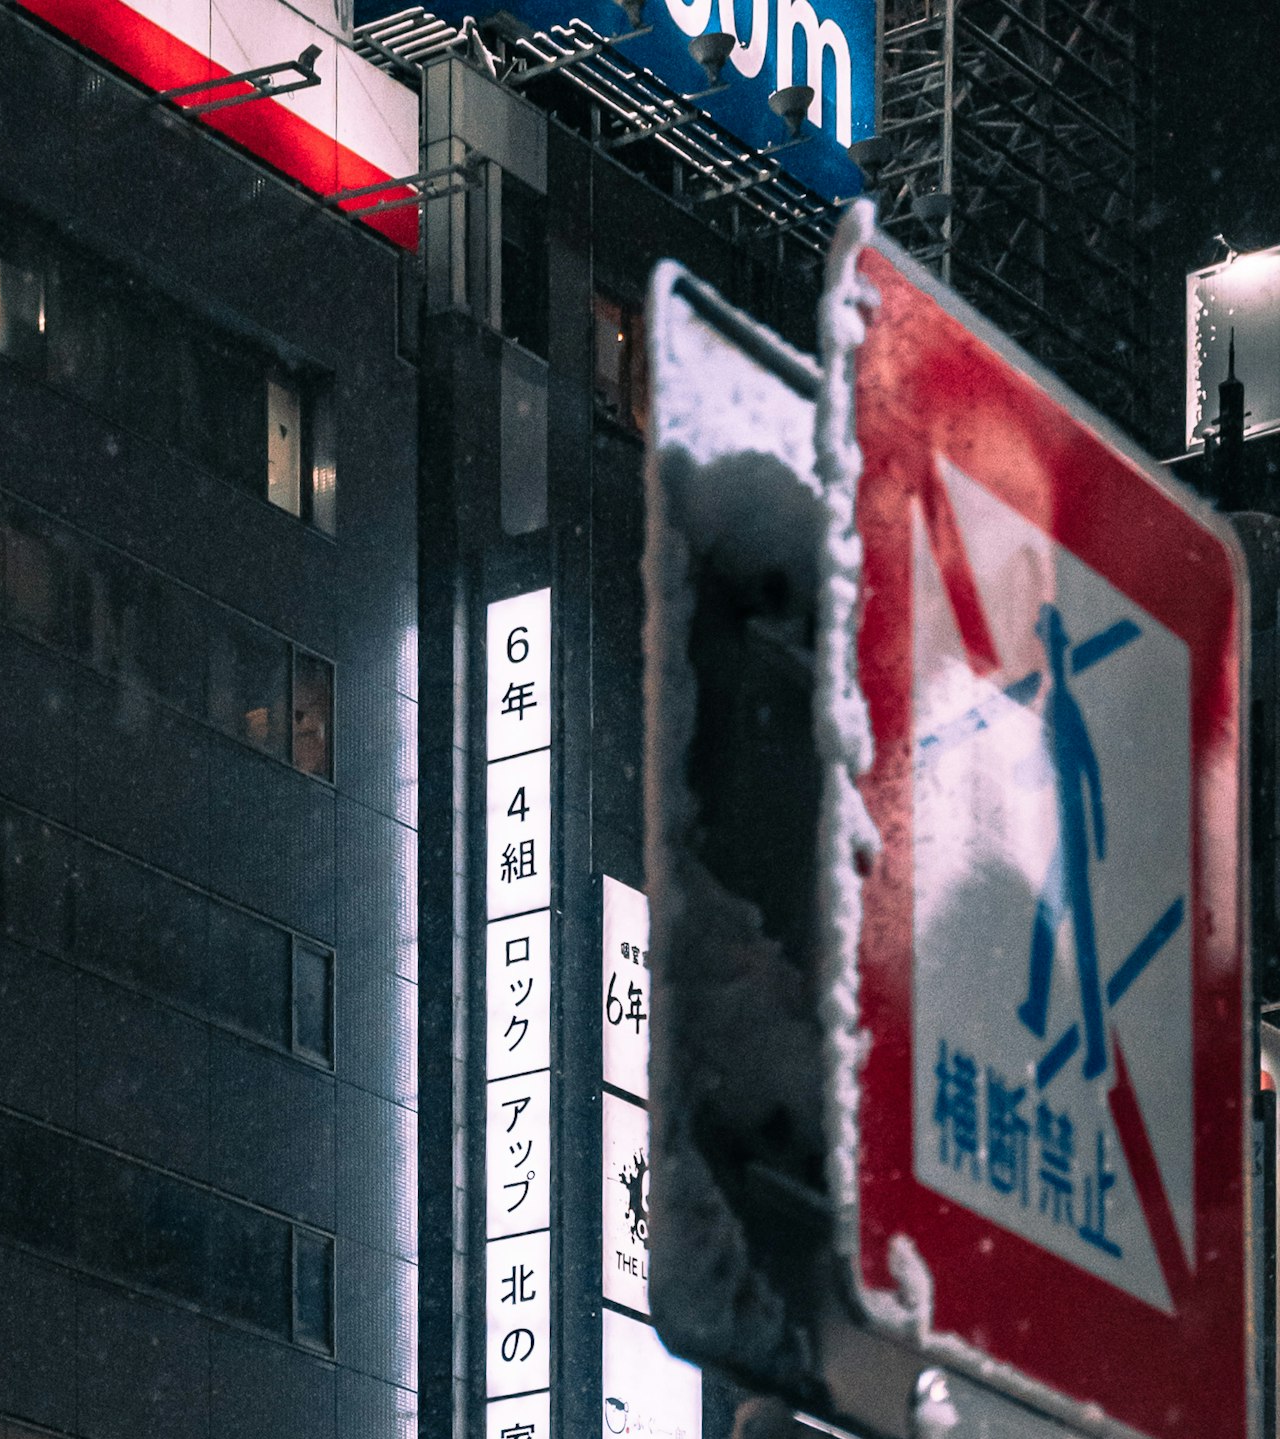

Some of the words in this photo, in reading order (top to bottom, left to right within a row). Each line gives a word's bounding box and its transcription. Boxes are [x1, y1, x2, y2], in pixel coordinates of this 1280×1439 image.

[664, 0, 851, 149] om
[501, 936, 535, 1212] ロックアップ
[934, 1039, 1123, 1258] 横断禁止
[617, 1250, 638, 1278] THE
